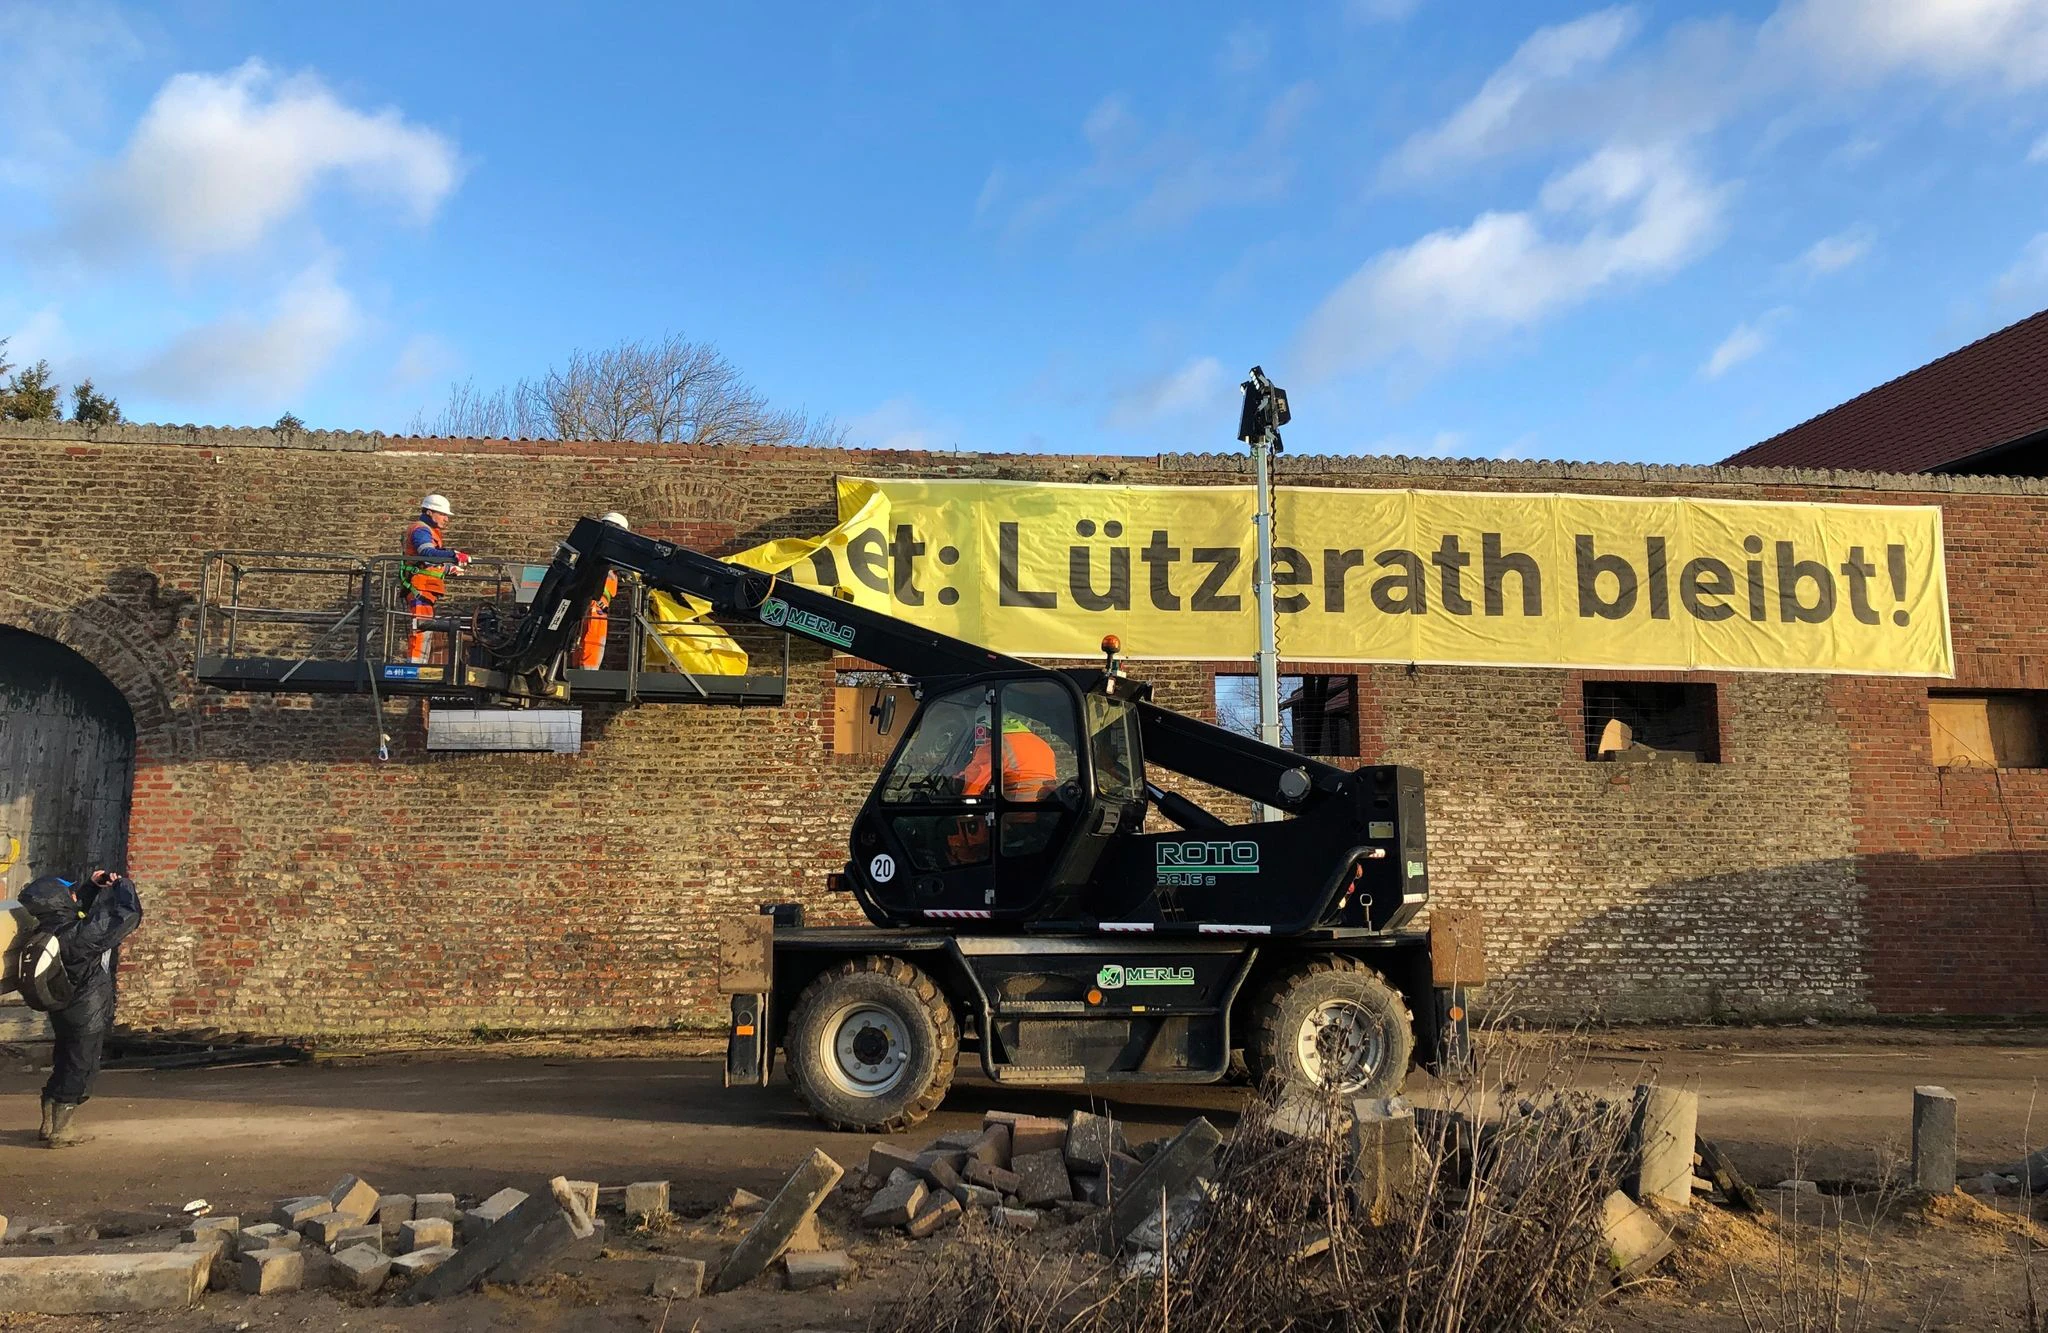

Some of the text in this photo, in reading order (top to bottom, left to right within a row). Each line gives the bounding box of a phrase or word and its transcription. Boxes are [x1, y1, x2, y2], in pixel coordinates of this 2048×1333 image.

[999, 519, 1543, 618] Lützerath
[1575, 534, 1912, 628] bleibt!
[787, 606, 856, 643] MERLO
[1156, 841, 1259, 865] ROTO
[875, 858, 891, 877] 20
[1125, 967, 1195, 981] MERLO
